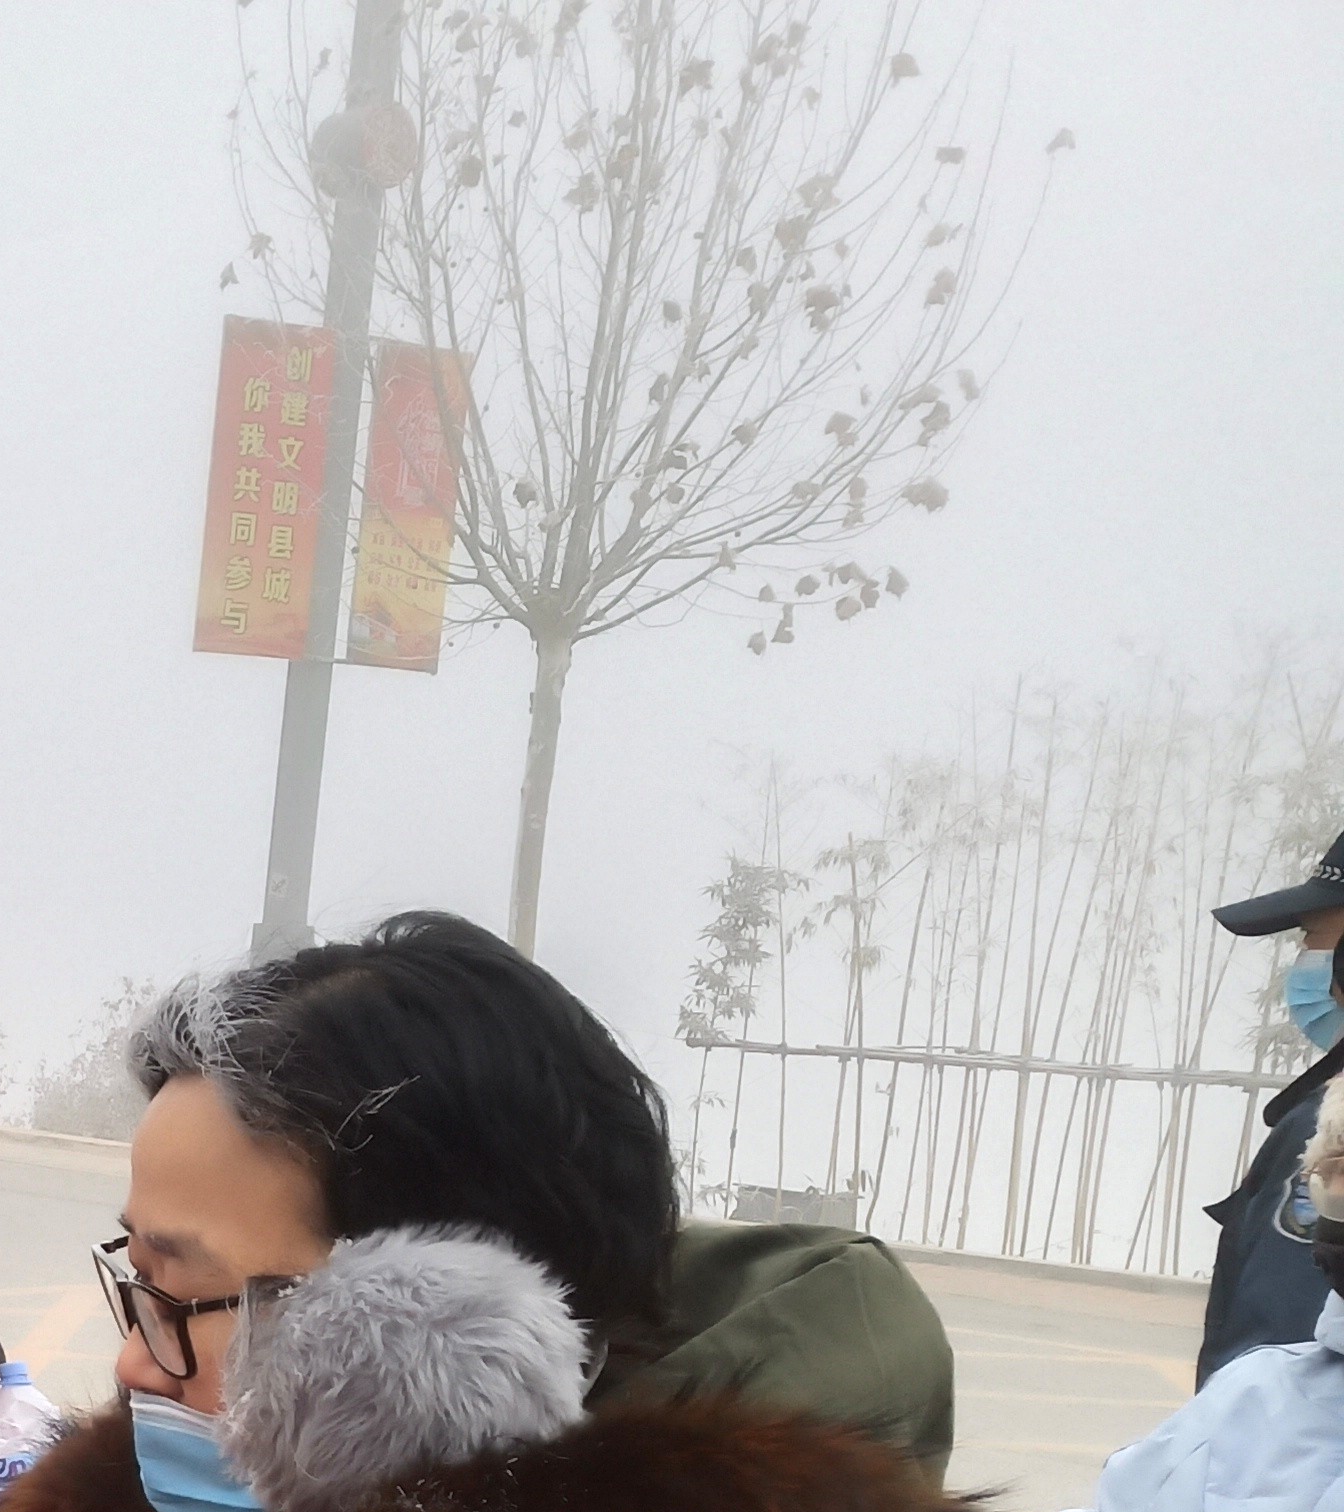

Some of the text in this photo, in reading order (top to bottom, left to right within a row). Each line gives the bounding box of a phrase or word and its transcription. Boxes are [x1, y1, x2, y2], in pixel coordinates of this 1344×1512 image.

[220, 377, 271, 635] 你我共同参与
[262, 345, 314, 604] 创建文明县城
